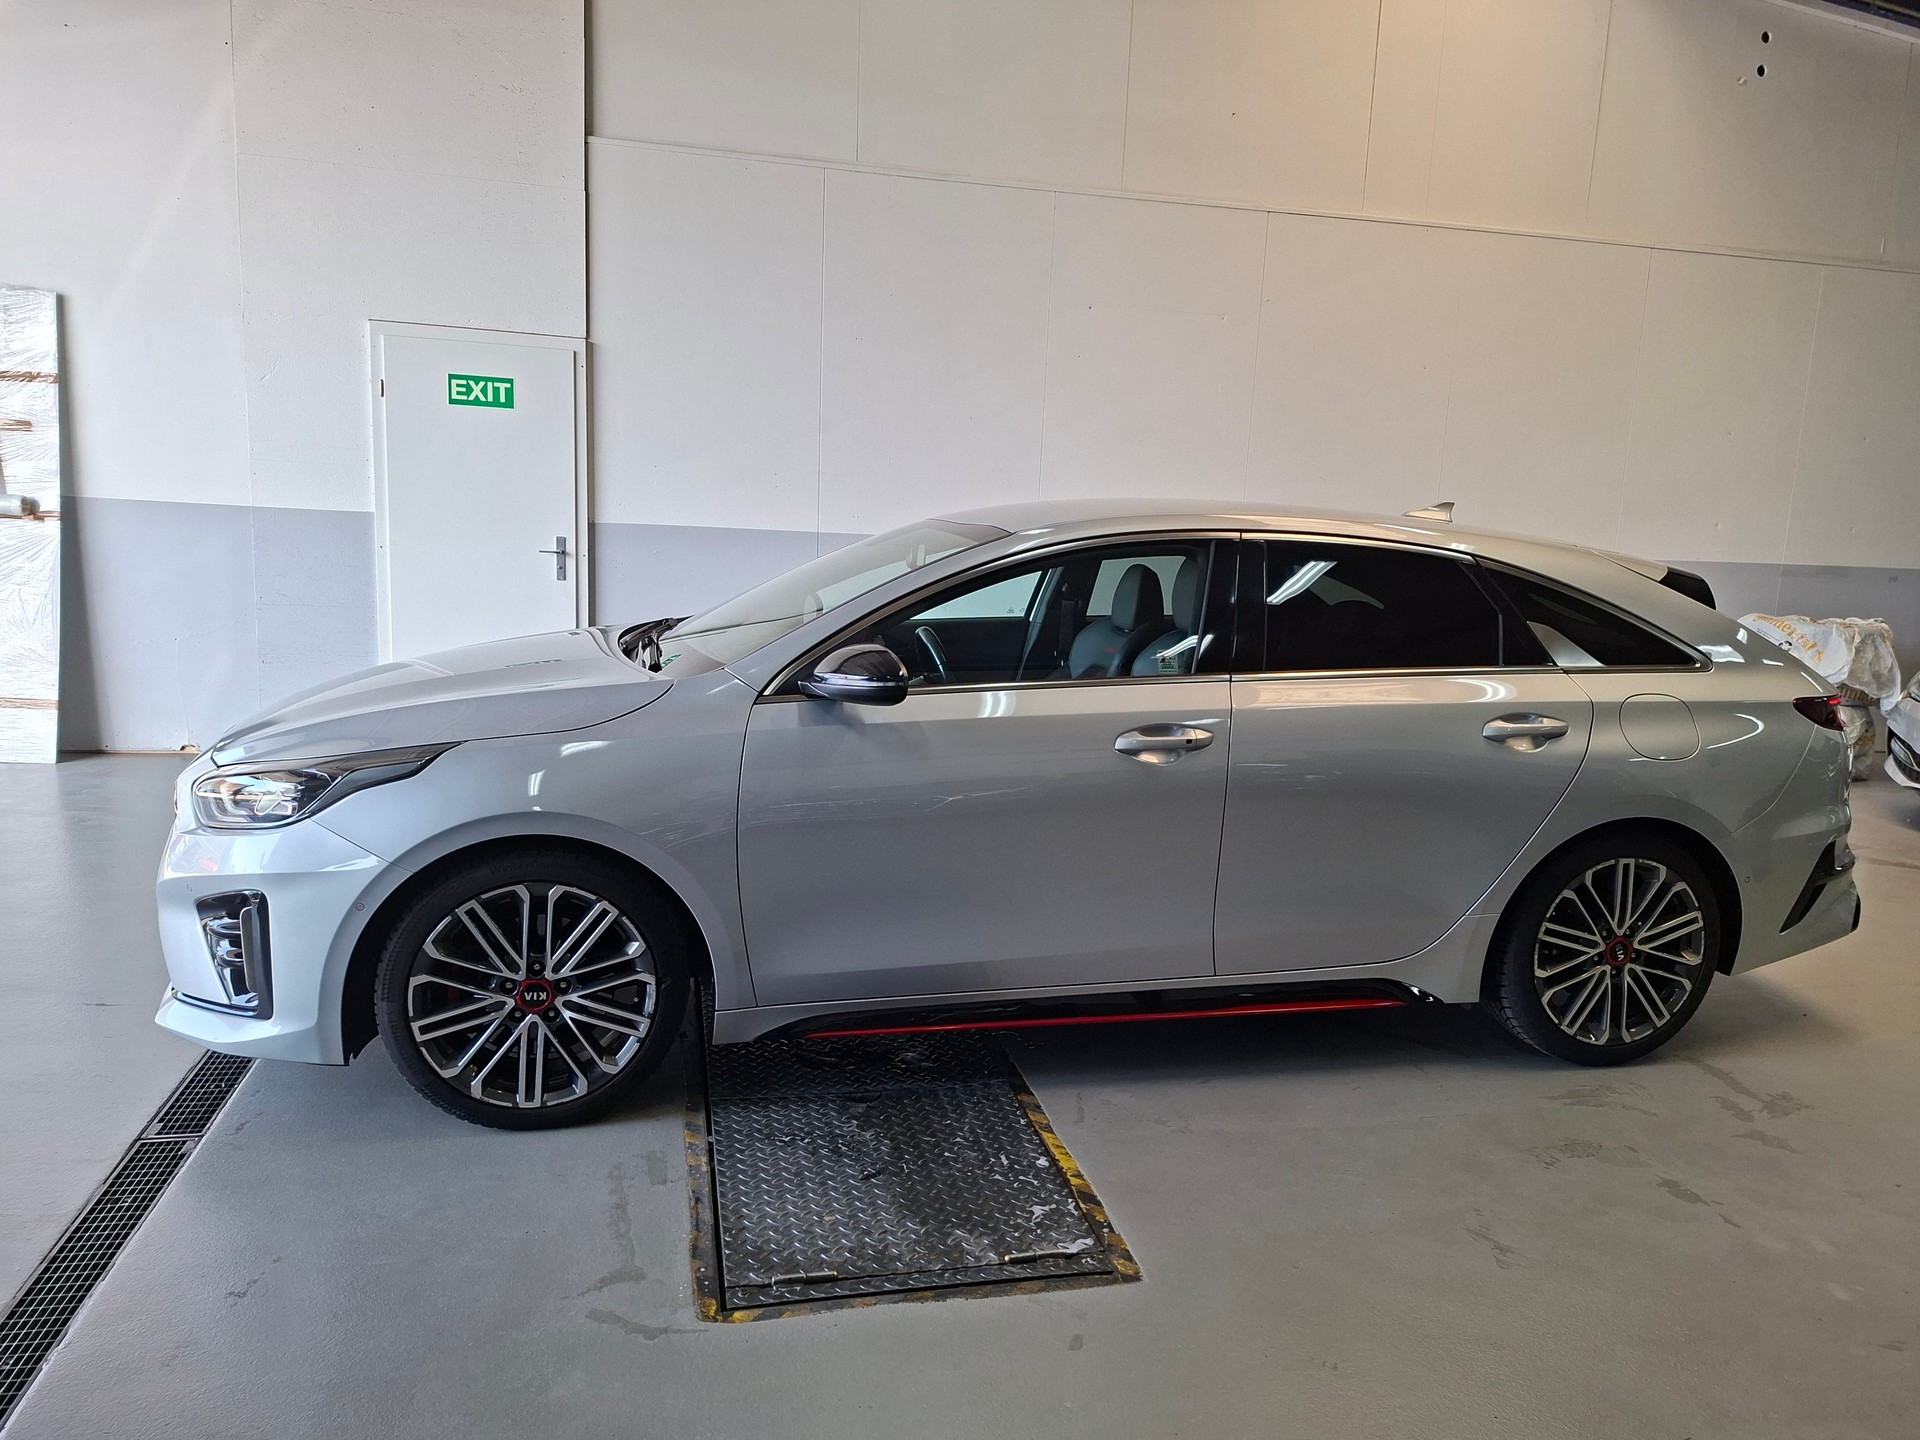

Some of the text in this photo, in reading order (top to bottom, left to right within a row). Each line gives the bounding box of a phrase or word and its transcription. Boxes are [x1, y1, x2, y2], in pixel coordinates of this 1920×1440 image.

[450, 379, 512, 403] EXIT
[1615, 943, 1625, 961] KIA
[524, 991, 547, 1001] KIA
